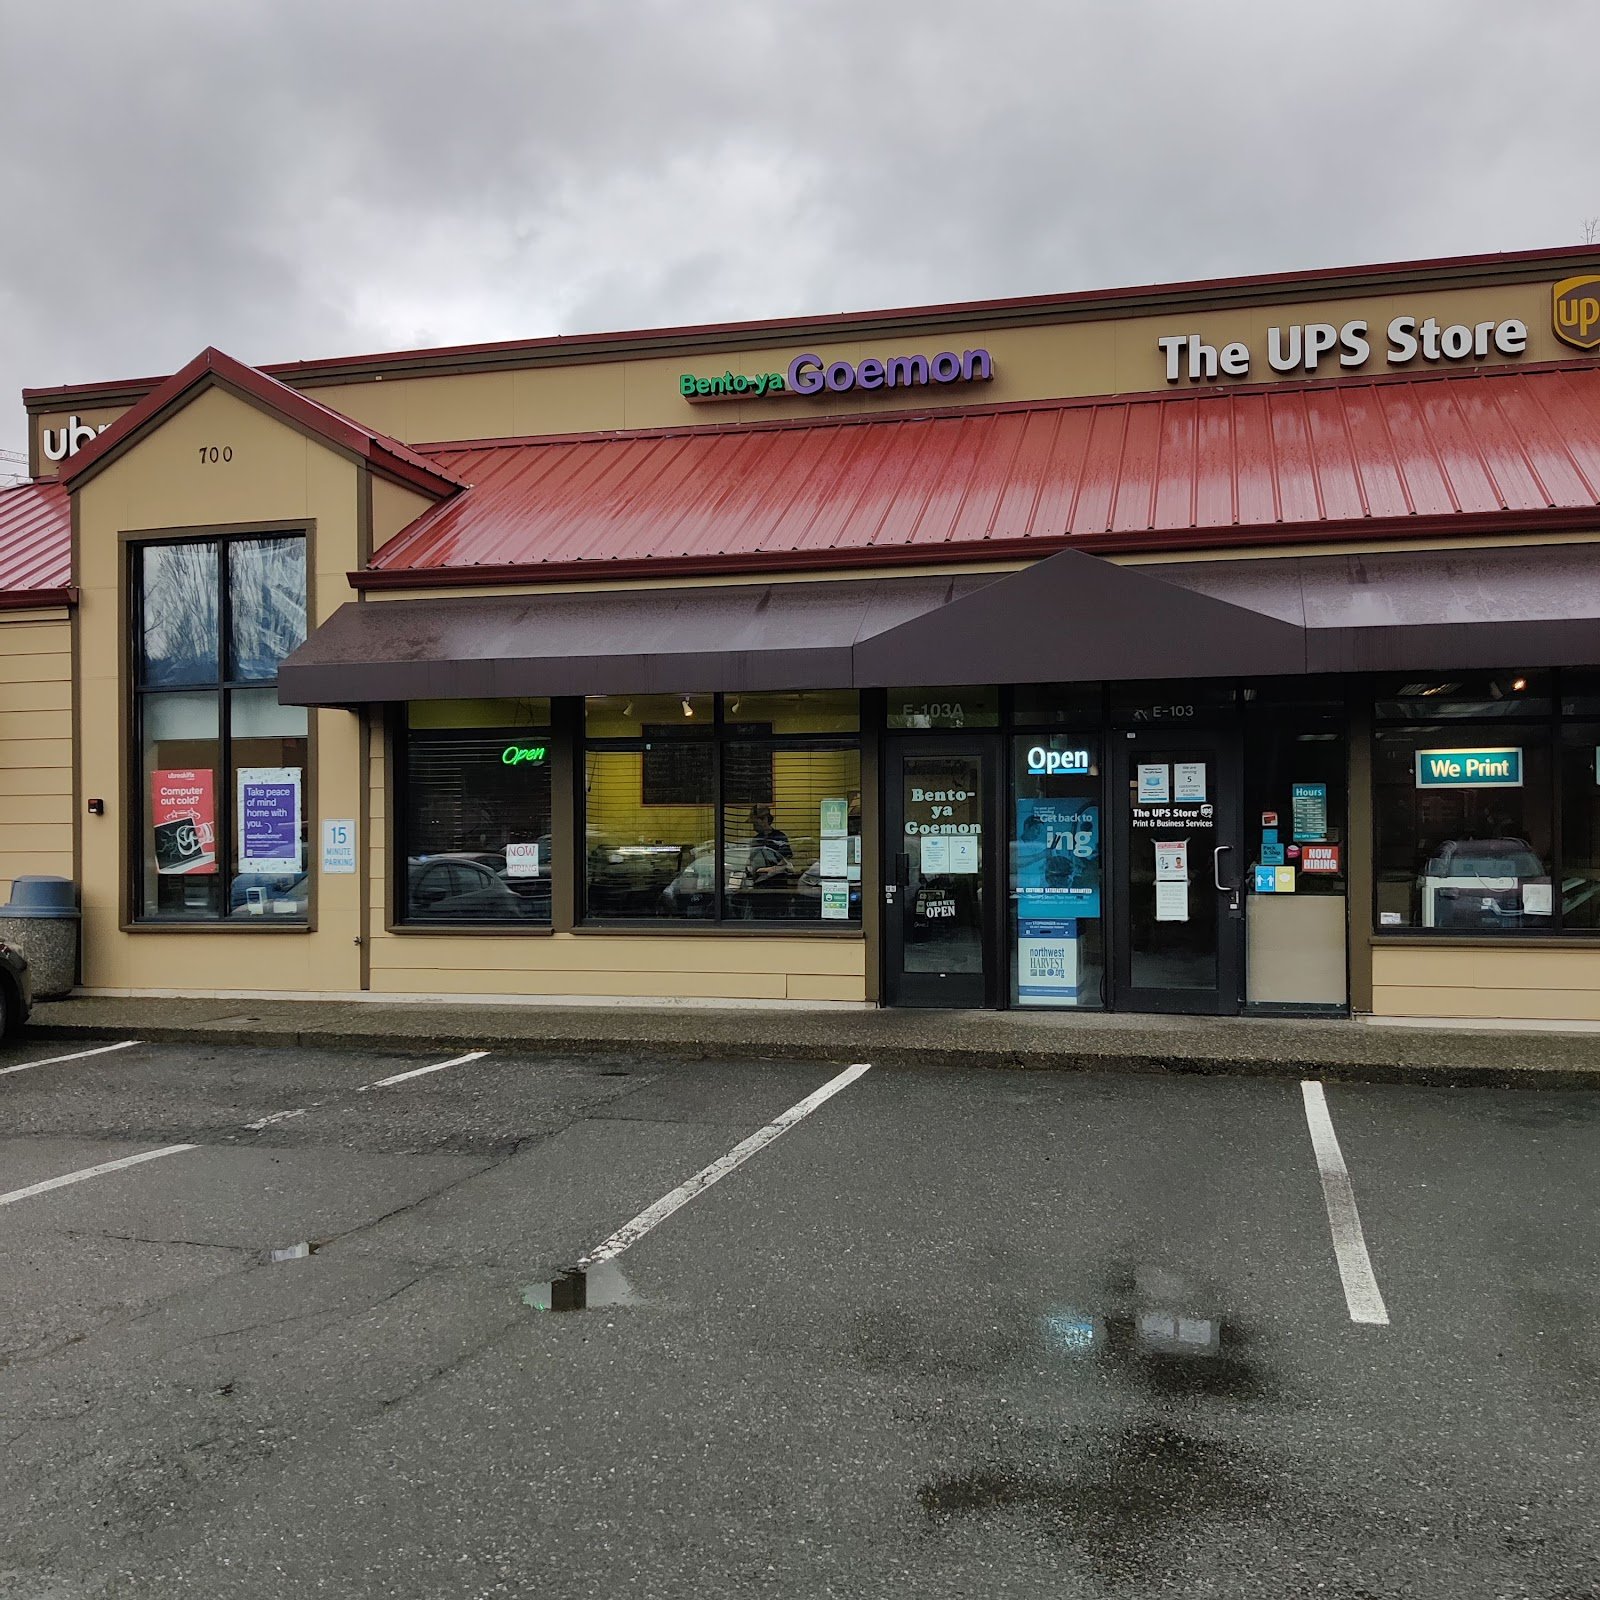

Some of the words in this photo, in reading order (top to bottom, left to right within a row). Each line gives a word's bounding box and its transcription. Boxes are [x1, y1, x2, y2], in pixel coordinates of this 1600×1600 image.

[1560, 298, 1600, 336] up
[1158, 335, 1250, 381] The
[1268, 320, 1370, 372] UPS
[1387, 316, 1528, 363] Store
[680, 371, 785, 395] Bento-ya
[788, 349, 990, 394] Goemon
[199, 446, 232, 464] 700
[902, 703, 964, 718] E-103A
[1152, 705, 1194, 718] E-103
[502, 746, 545, 765] Open
[1027, 746, 1088, 774] Open
[1430, 760, 1460, 777] We
[1466, 759, 1509, 776] Print
[1186, 775, 1192, 783] 5
[160, 787, 203, 796] Computer
[246, 788, 264, 796] Take
[266, 789, 290, 798] peace
[911, 789, 975, 802] Bento-
[1296, 788, 1322, 796] Hours
[160, 797, 176, 805] out
[176, 796, 199, 805] cold?
[246, 798, 255, 806] of
[257, 798, 277, 806] mind
[246, 809, 270, 817] home
[271, 808, 288, 817] with
[931, 805, 952, 819] ya
[1132, 808, 1150, 818] The
[1152, 808, 1171, 818] UPS
[1173, 808, 1198, 818] Store
[1040, 813, 1057, 823] Get
[1058, 813, 1080, 822] back
[1081, 813, 1093, 822] to
[246, 821, 263, 830] you.
[904, 822, 981, 835] Goemon
[1132, 820, 1149, 828] Print
[1149, 820, 1156, 828] &
[1156, 820, 1185, 828] Business
[1185, 820, 1213, 828] Services
[330, 826, 347, 844] 15
[1046, 825, 1093, 858] ing
[326, 848, 351, 856] MINUTE
[508, 846, 536, 857] NOW
[960, 846, 966, 854] 2
[1309, 849, 1332, 858] NOW
[508, 864, 538, 873] HIRING
[1304, 859, 1337, 870] HIRING
[926, 906, 956, 918] OPEN
[1029, 947, 1065, 958] northwest
[1030, 958, 1064, 968] HARVEST
